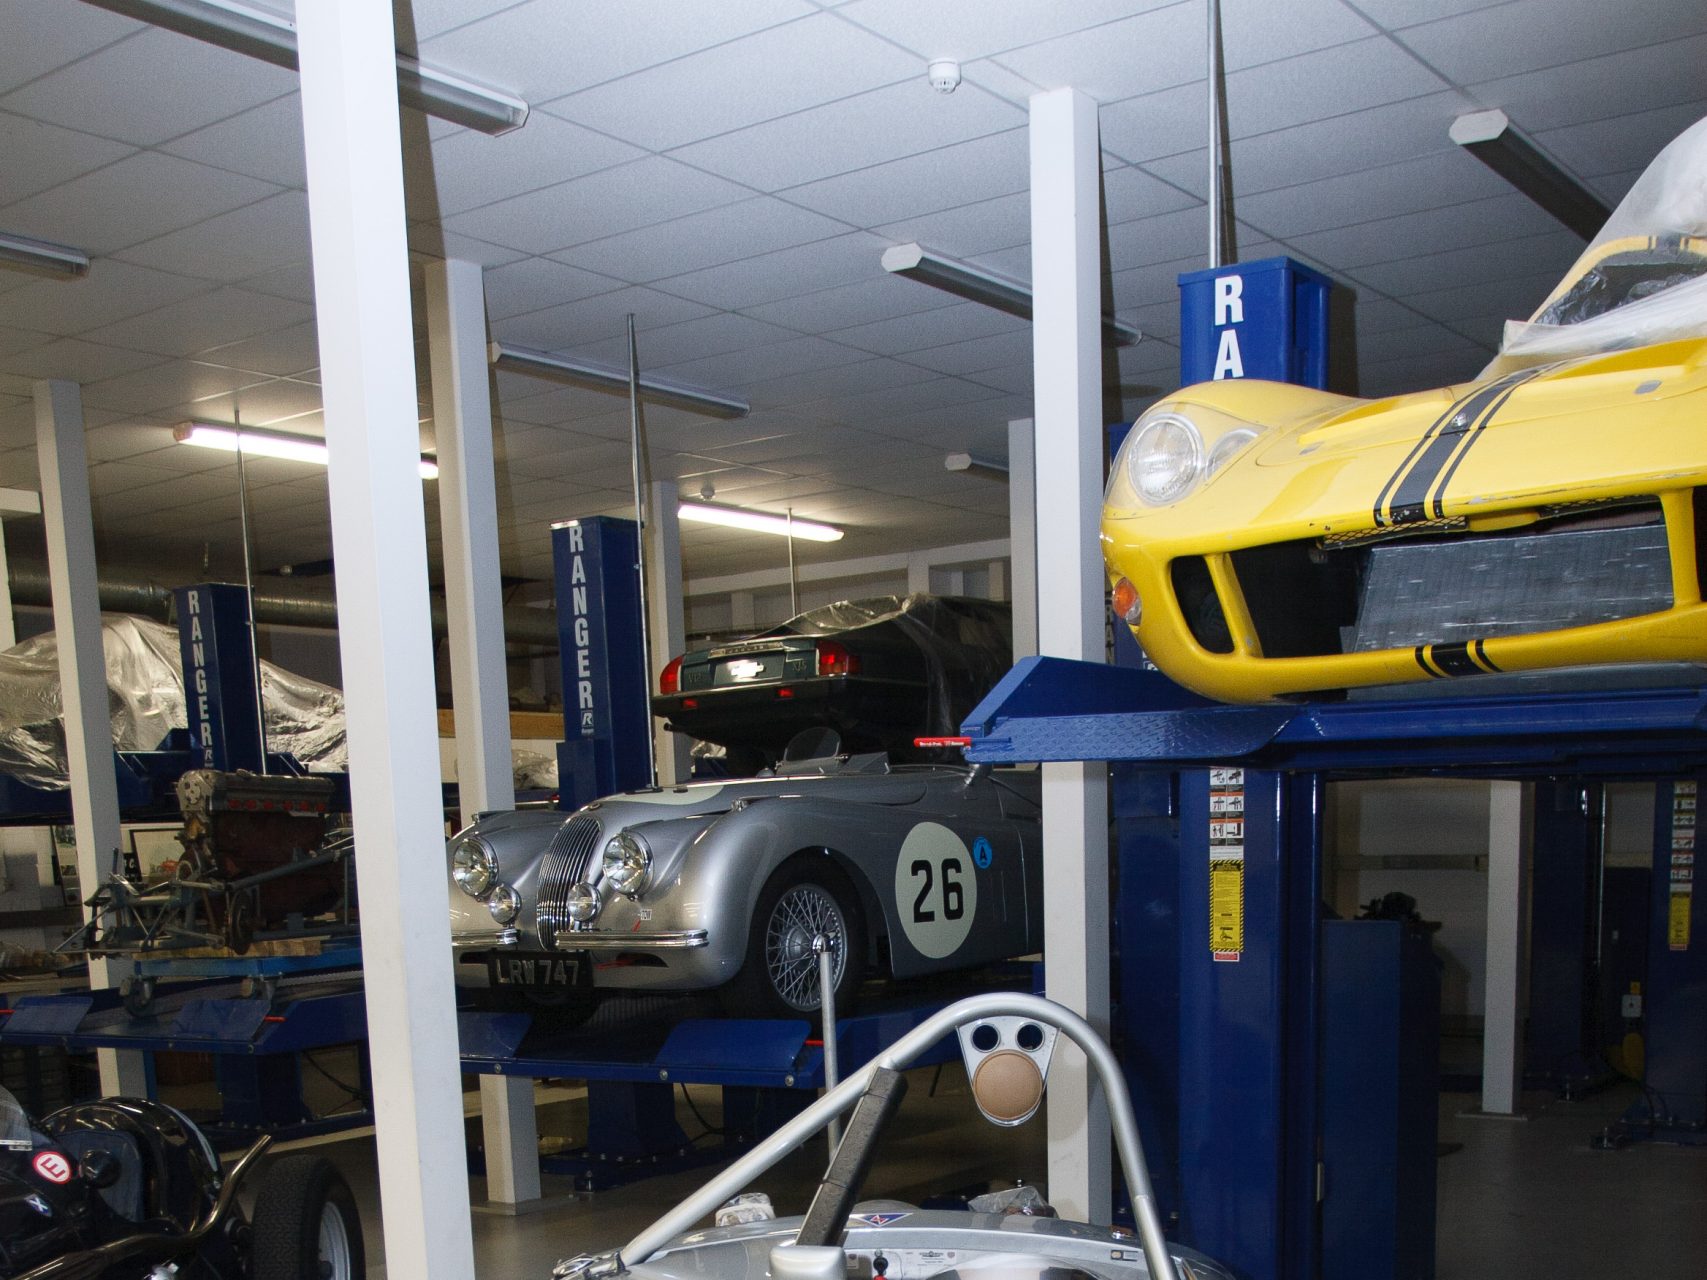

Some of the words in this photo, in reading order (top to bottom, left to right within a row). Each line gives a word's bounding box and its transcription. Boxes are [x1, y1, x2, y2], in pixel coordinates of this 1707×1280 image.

[1213, 275, 1244, 380] RA
[569, 525, 593, 709] RANGER
[188, 590, 213, 747] RANGER
[911, 858, 964, 923] 26
[496, 959, 535, 985] LRW
[538, 959, 579, 985] 747
[40, 1157, 66, 1179] E
